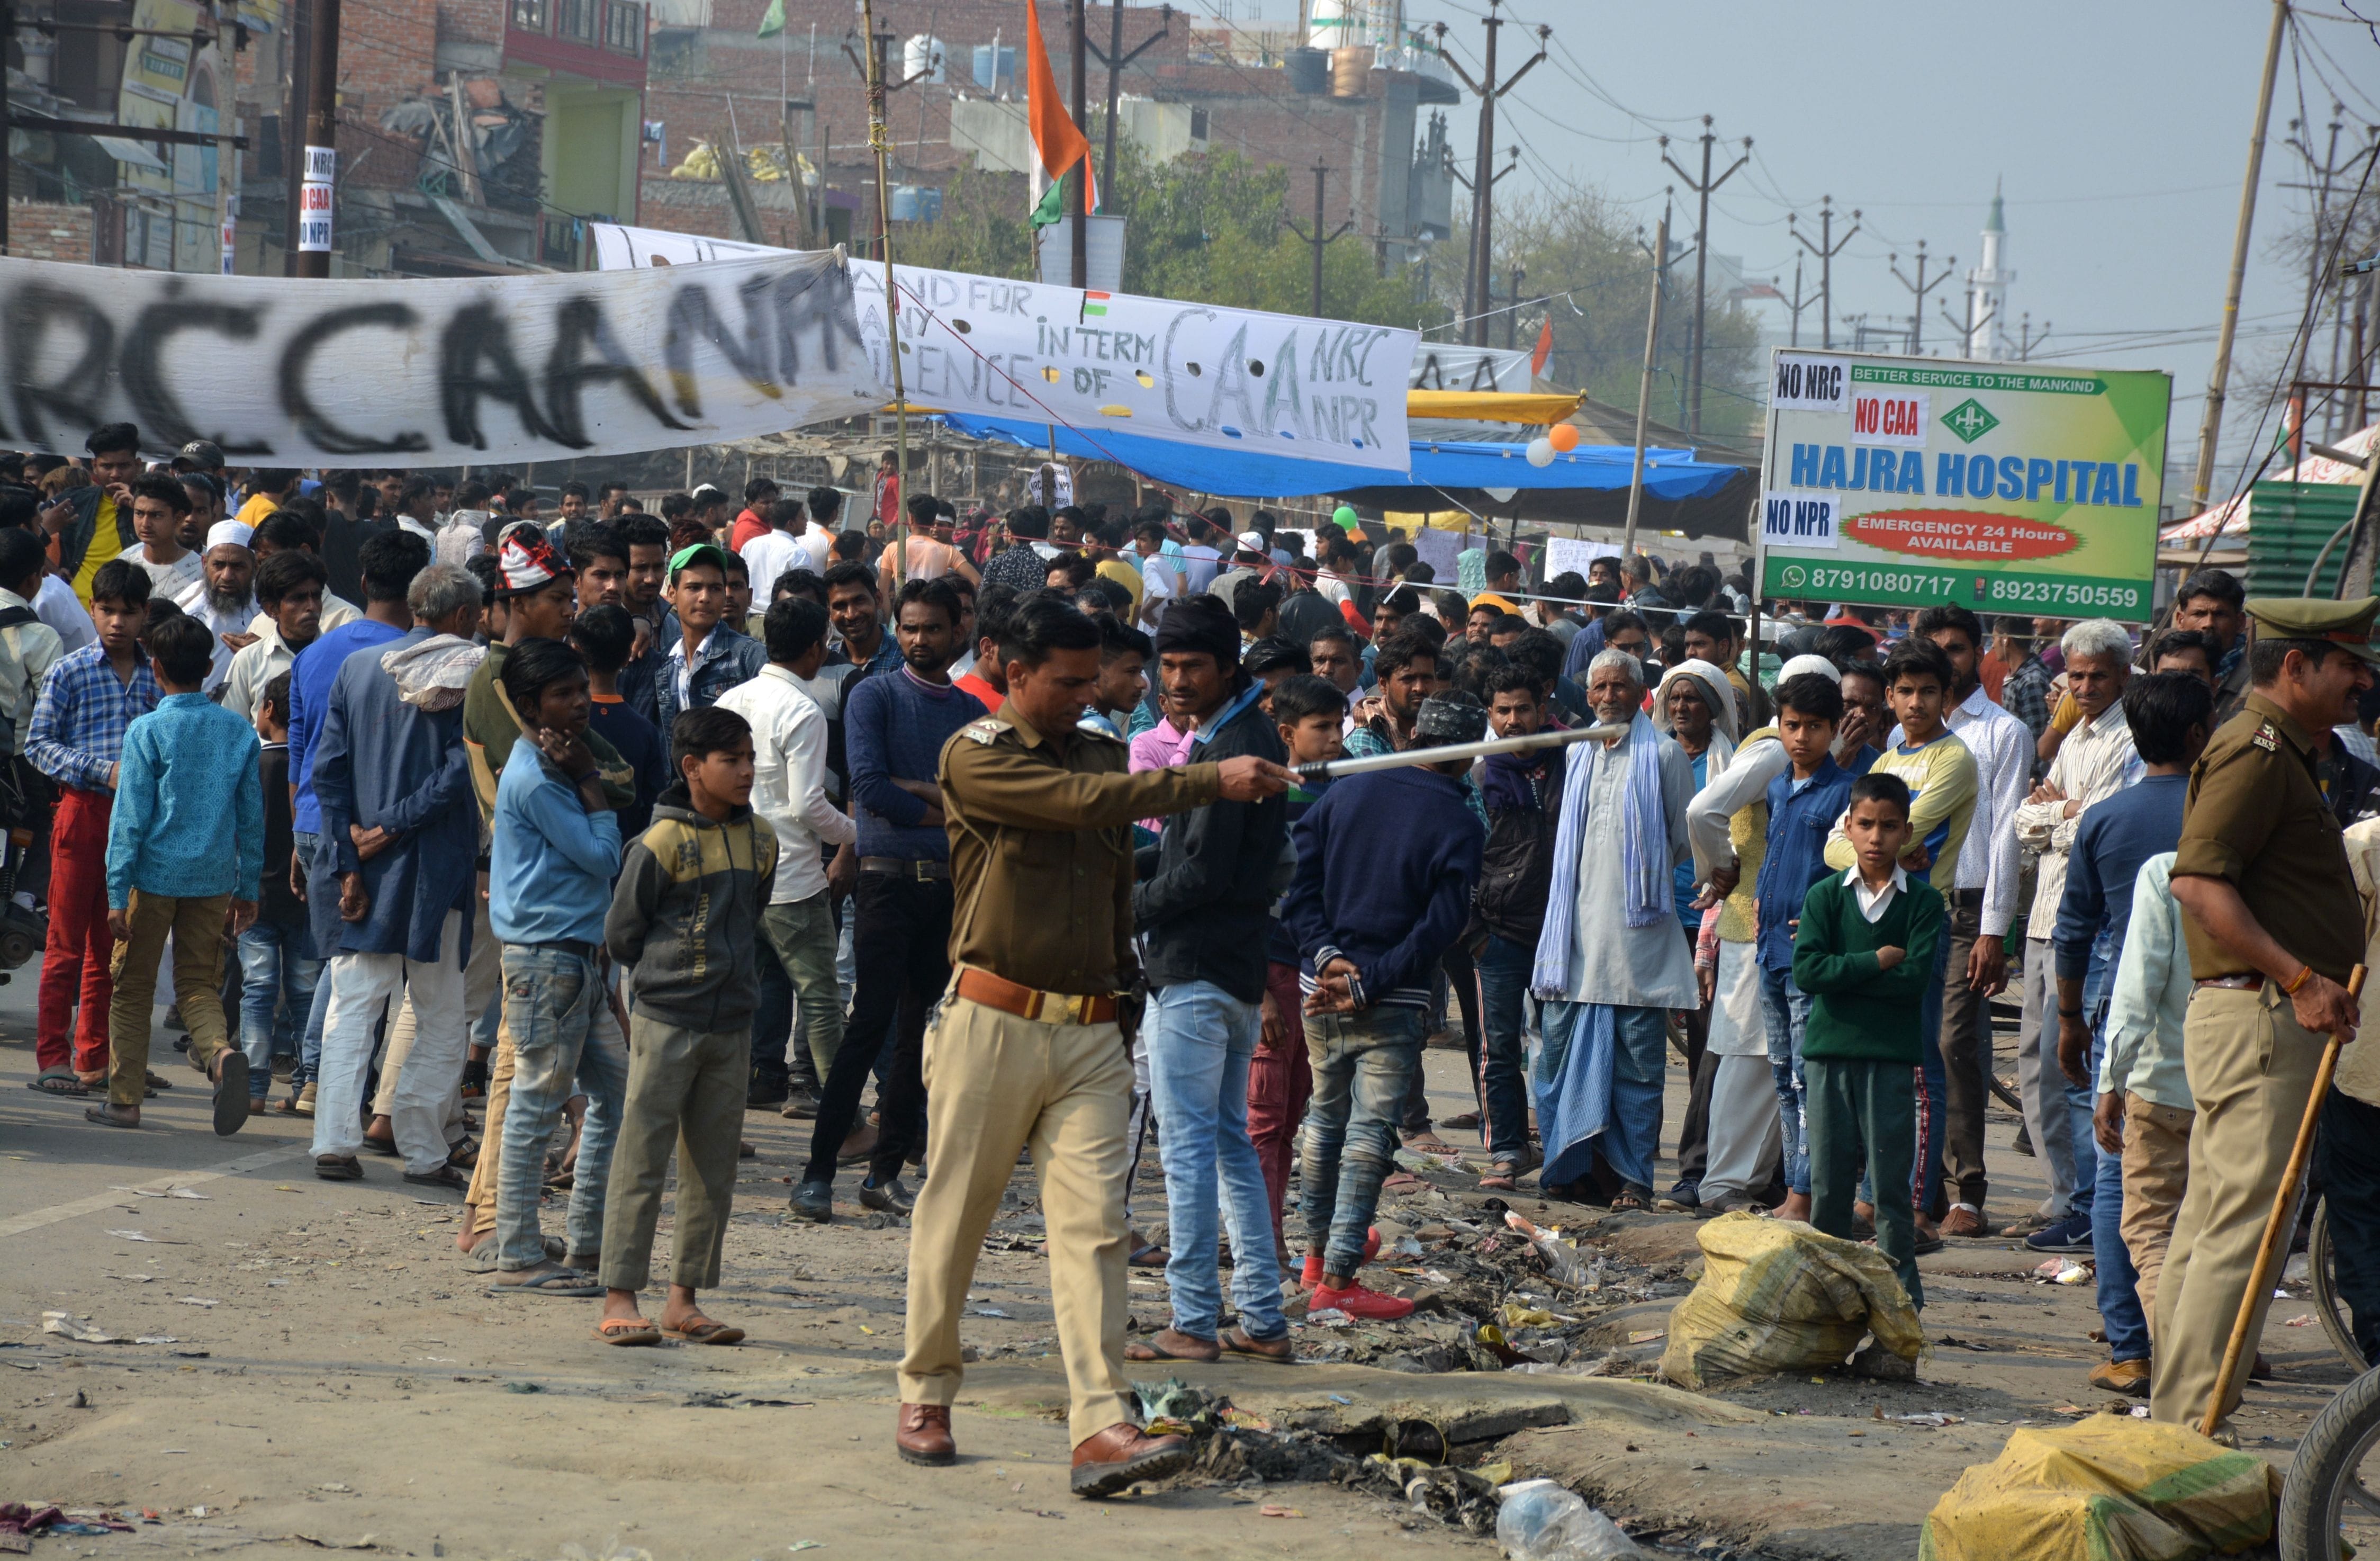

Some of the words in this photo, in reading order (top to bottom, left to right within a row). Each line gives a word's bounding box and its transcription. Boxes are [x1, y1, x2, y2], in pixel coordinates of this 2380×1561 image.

[313, 151, 332, 175] NRC
[309, 188, 330, 211] CAA
[310, 222, 329, 244] NPR
[968, 280, 1033, 318] FOR
[859, 303, 935, 339] ANY
[1309, 326, 1391, 388] NRC
[1073, 366, 1111, 398] OF
[1164, 307, 1312, 442] CAA
[1777, 364, 1801, 399] NO
[1805, 365, 1842, 401] NRC
[1854, 367, 1908, 383] BETTER
[1912, 371, 1972, 387] SERVICE
[1976, 374, 1995, 388] TO
[1998, 375, 2025, 389] THE
[2029, 378, 2095, 393] MANKIND
[1312, 394, 1382, 450] NPR
[1854, 398, 1881, 434] NO
[1883, 399, 1918, 436] CAA
[1790, 443, 1926, 496] HAJRA
[1936, 452, 2143, 508] HOSPITAL
[1766, 498, 1791, 535] NO
[1795, 500, 1831, 537] NPR
[1857, 517, 1978, 537] EMERGENCY
[1982, 525, 2006, 539] 24
[2011, 527, 2067, 542] Hours
[1907, 536, 2013, 554] AVAILABLE
[1812, 568, 1956, 597] 8791080717
[1991, 579, 2139, 608] 8923750559
